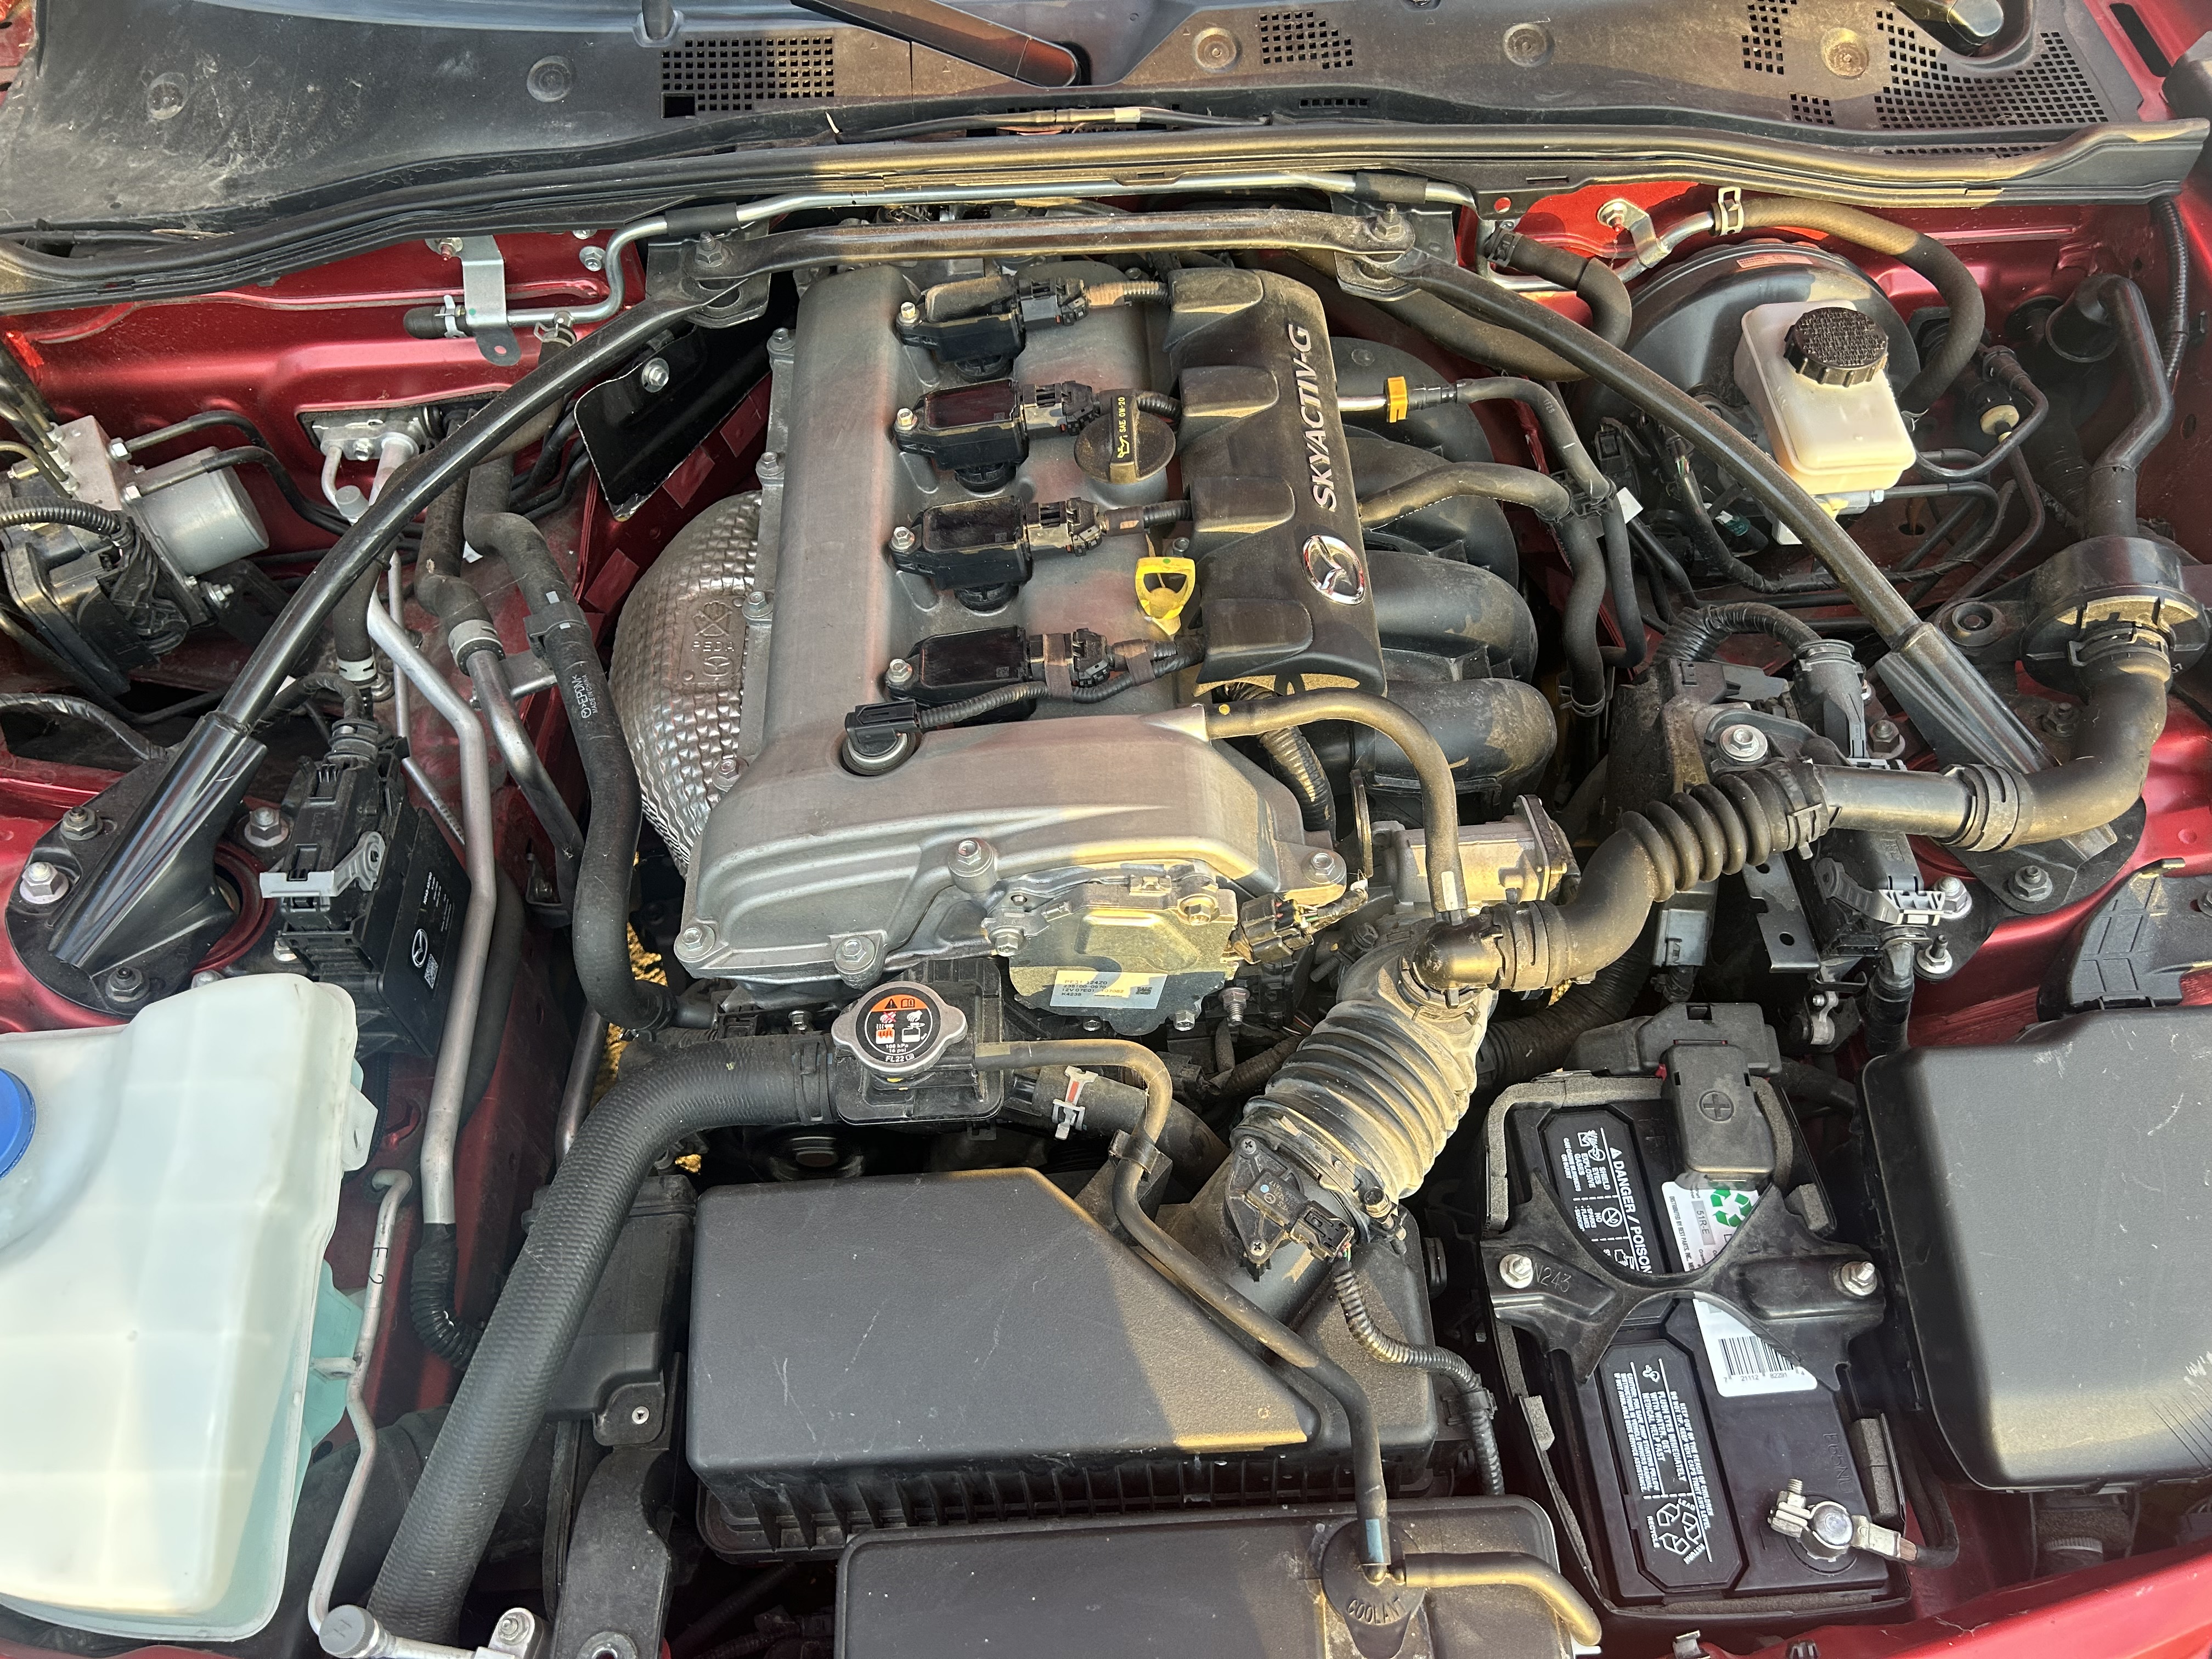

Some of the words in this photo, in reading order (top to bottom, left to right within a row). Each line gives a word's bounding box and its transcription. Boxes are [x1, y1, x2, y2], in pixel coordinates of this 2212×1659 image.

[1118, 396, 1126, 417] 0W-20
[1119, 419, 1127, 433] SAE
[1286, 324, 1337, 513] SKYACTIV-G
[588, 690, 594, 698] IN
[588, 697, 599, 714] MADE
[1562, 1160, 1572, 1179] INJURY
[1563, 1137, 1571, 1149] CAN
[1569, 1165, 1582, 1192] BLINDNESS
[1574, 1153, 1585, 1176] GASES
[1581, 1153, 1596, 1188] EXPLOSIVE
[1592, 1167, 1602, 1185] EYES
[1599, 1166, 1611, 1190] SHIELD
[1594, 1212, 1603, 1223] NO
[1613, 1161, 1636, 1212] DANGER
[1630, 1226, 1652, 1273] POISON
[1669, 1196, 1681, 1220] DISTRIBUTED
[1678, 1227, 1686, 1237] BEST
[1696, 1210, 1710, 1235] 51R-E
[1532, 1261, 1573, 1293] N243
[1615, 1379, 1624, 1391] NOT
[1618, 1389, 1630, 1419] AVAILABLE
[1632, 1398, 1640, 1409] FOR
[1657, 1391, 1670, 1414] FLUSH
[1668, 1391, 1678, 1401] DO
[1620, 1373, 1635, 1411] INSTRUCTIONS
[1630, 1418, 1642, 1441] VEHICLE
[1635, 1409, 1644, 1424] SAFE
[1642, 1392, 1655, 1423] MEDICAL
[1671, 1401, 1681, 1413] NOT
[1679, 1402, 1689, 1417] KEEP
[1624, 1419, 1634, 1434] SEEK
[1638, 1424, 1648, 1440] JUMP
[1649, 1392, 1661, 1410] WITH
[1655, 1411, 1667, 1438] WATER.
[1661, 1440, 1672, 1454] GET
[1663, 1414, 1674, 1433] EYES
[1683, 1418, 1692, 1431] OUT
[1649, 1424, 1661, 1442] HELP
[1679, 1426, 1689, 1442] KEEP
[1687, 1430, 1695, 1441] OF
[1628, 1434, 1639, 1457] SERVICE
[1643, 1440, 1655, 1467] STARTING
[1654, 1443, 1666, 1462] FAST
[1683, 1443, 1692, 1458] VENT
[1689, 1441, 1698, 1453] THE
[1668, 1434, 1687, 1482] IMMEDIATELY
[1687, 1459, 1697, 1476] CAPS
[1692, 1454, 1703, 1474] REACH
[1633, 1457, 1647, 1493] ASSISTANCE.
[1649, 1467, 1660, 1491] FOLLOW
[1698, 1473, 1706, 1484] OF
[1692, 1476, 1702, 1495] TIGHT
[1678, 1498, 1695, 1511] LEAD
[1696, 1494, 1705, 1509] AND
[1701, 1484, 1714, 1516] CHILDREN
[1700, 1510, 1711, 1530] LEVEL
[1647, 1515, 1660, 1548] RECYCLE
[1683, 1543, 1705, 1565] RETURN
[1346, 1596, 1403, 1626] COOLANT
